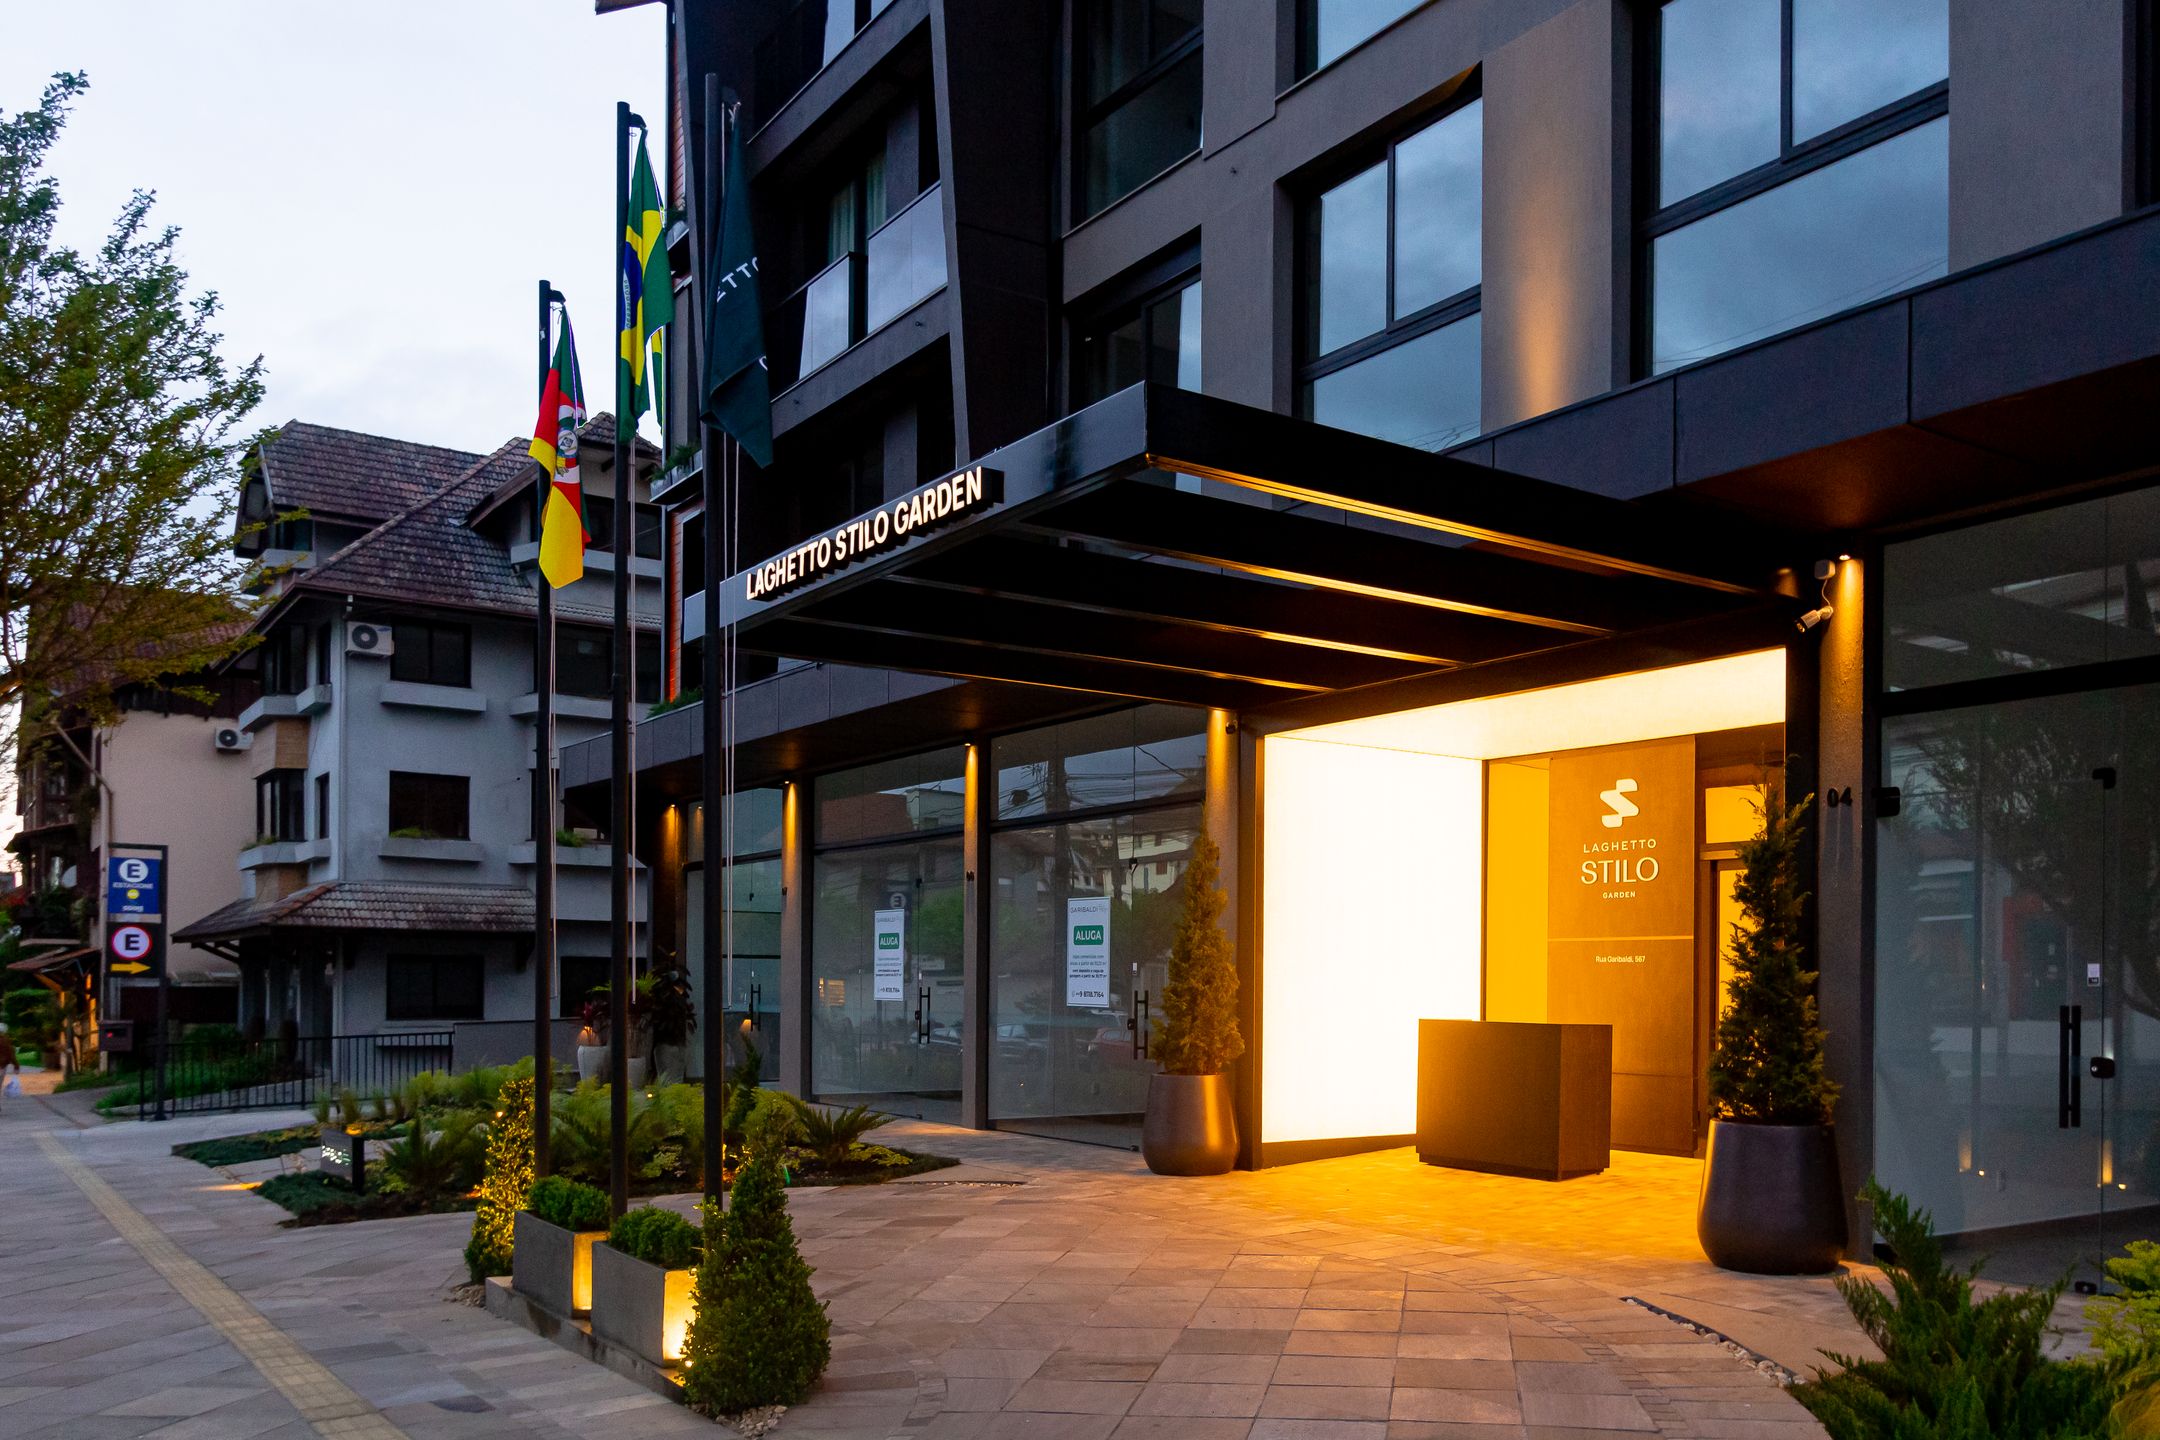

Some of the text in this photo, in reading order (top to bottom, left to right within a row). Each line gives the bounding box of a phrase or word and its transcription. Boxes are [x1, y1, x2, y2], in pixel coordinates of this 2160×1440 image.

[746, 465, 983, 601] LAGHETTO STILO GARDEN
[1826, 786, 1853, 808] 04
[1583, 838, 1657, 854] LAGHETTO
[127, 863, 140, 879] E
[1580, 856, 1659, 885] STILO
[1602, 890, 1636, 899] GARDEN
[125, 934, 140, 951] E
[880, 936, 899, 946] ALUGA
[1075, 930, 1102, 941] ALUGA
[1595, 955, 1606, 963] Rua
